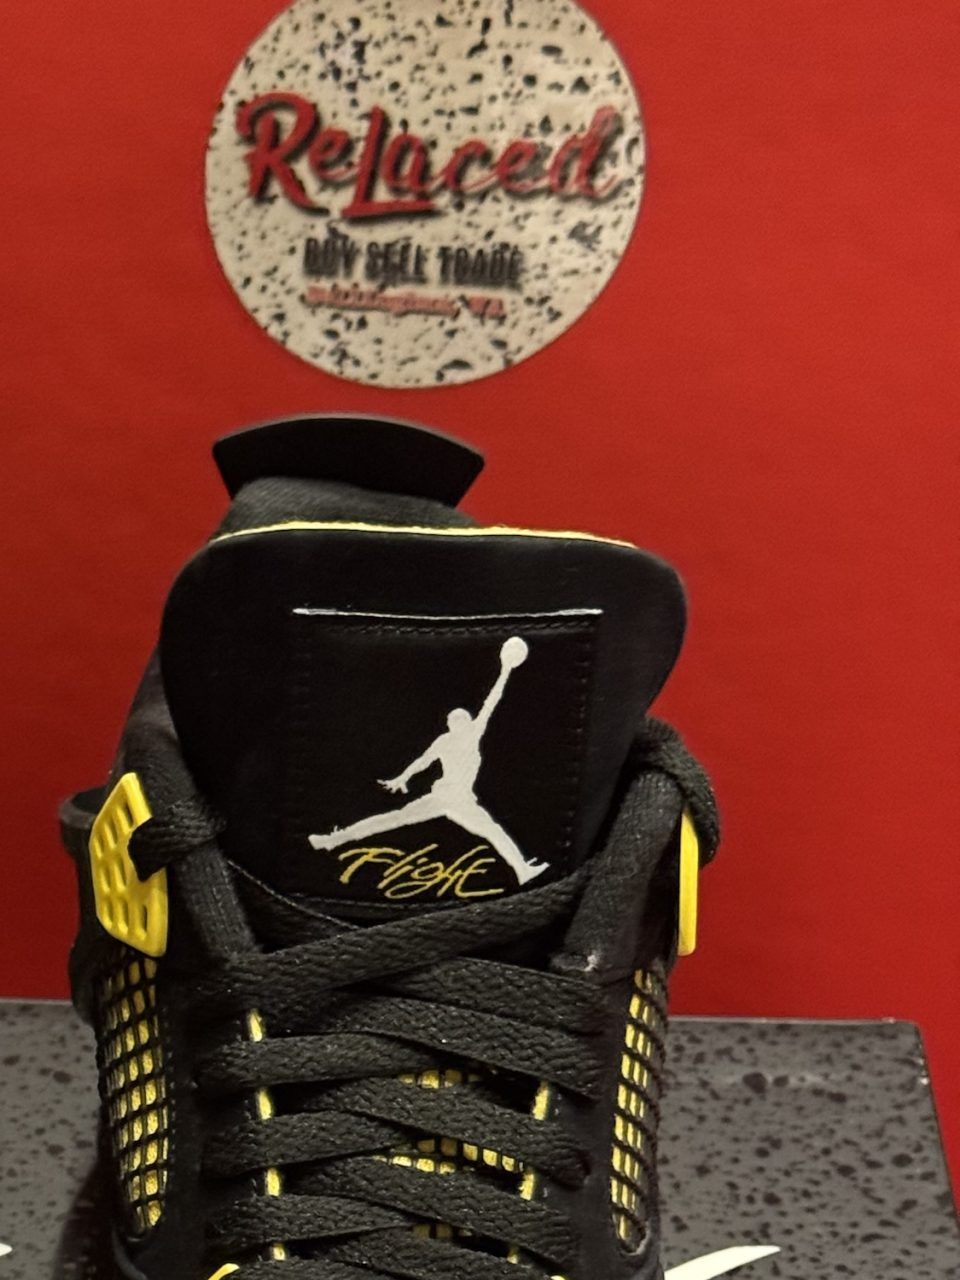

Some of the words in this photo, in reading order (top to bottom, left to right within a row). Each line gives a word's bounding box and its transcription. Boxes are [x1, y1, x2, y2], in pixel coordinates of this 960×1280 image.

[304, 236, 357, 277] BUY
[364, 240, 428, 285] SELL
[438, 244, 524, 290] TRADE
[338, 843, 505, 899] Flight
